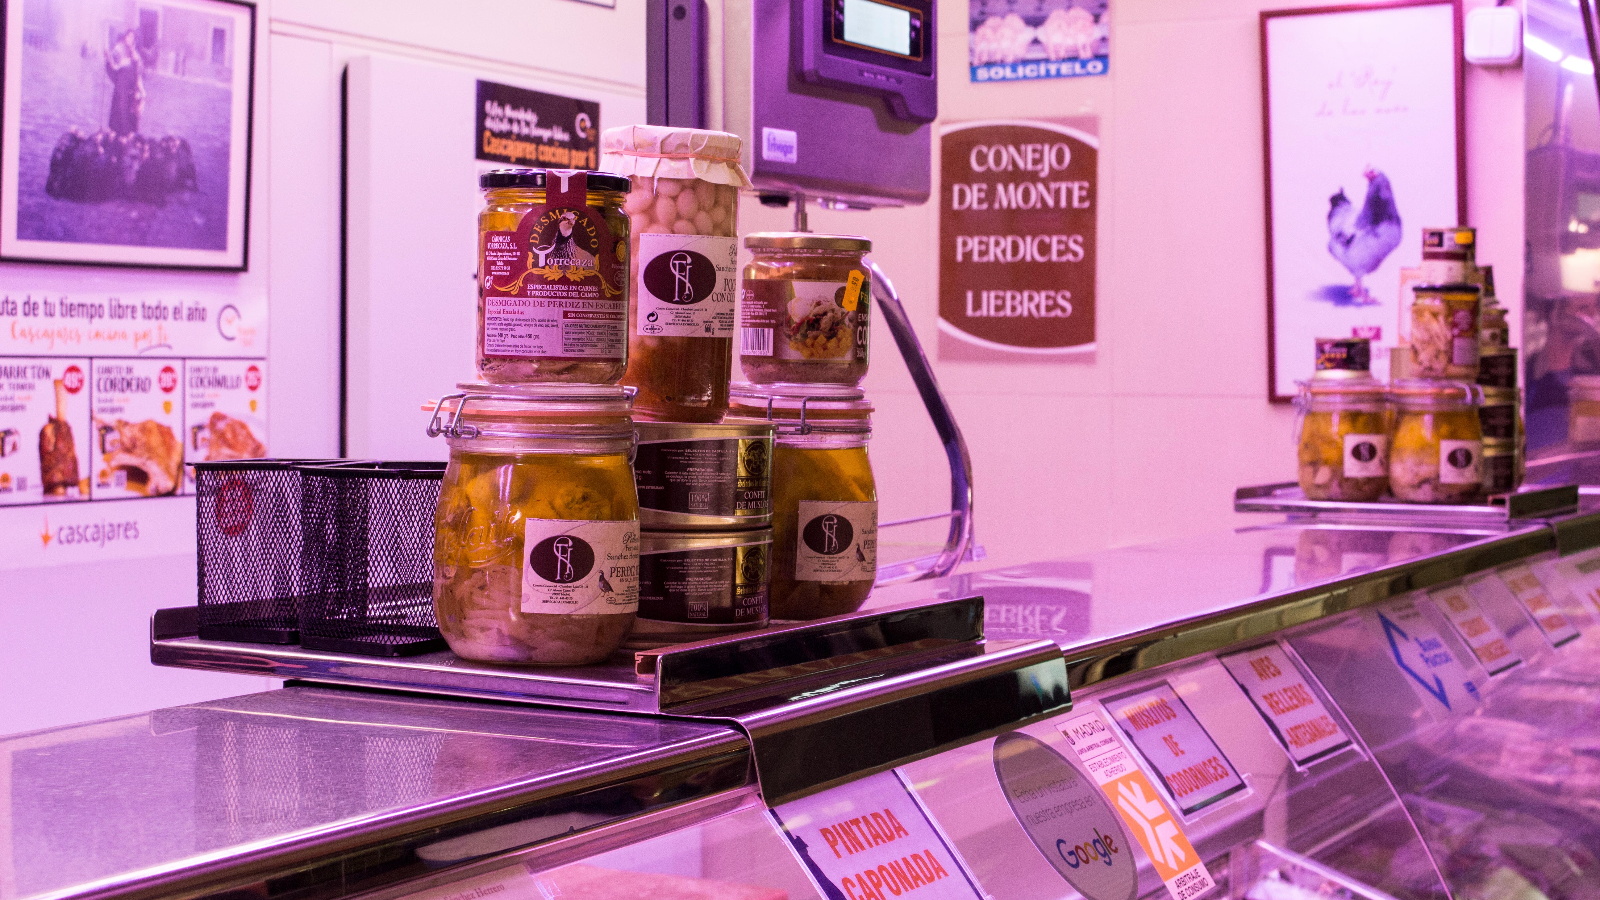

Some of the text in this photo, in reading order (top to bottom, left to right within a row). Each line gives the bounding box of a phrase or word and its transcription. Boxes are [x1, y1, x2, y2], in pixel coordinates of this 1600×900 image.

[970, 143, 1072, 178] CONEJO
[952, 181, 1090, 210] DE MONTE
[530, 208, 599, 249] DESMIGADO
[532, 243, 594, 268] Torrecaza
[956, 235, 1085, 263] PERDICES
[23, 295, 40, 317] de
[43, 297, 56, 318] tu
[59, 297, 105, 324] tiempo
[108, 298, 138, 320] libre
[141, 301, 170, 321] todo
[173, 301, 184, 321] el
[187, 301, 208, 322] año
[487, 300, 531, 308] DESMIGADO
[532, 300, 546, 308] DE
[547, 300, 581, 309] PERDIZ
[965, 290, 1073, 318] LIEBRES
[736, 501, 747, 510] DE
[57, 522, 140, 547] cascajares
[735, 608, 745, 617] DE
[1262, 683, 1314, 716] RELLENAS
[1072, 719, 1105, 740] MADRID
[1162, 733, 1185, 757] DE
[1165, 756, 1229, 797] CODORNICES
[819, 808, 909, 859] PINTADA
[1056, 827, 1119, 869] Google
[841, 849, 949, 900] CAPONADA
[474, 883, 505, 898] Herrero
